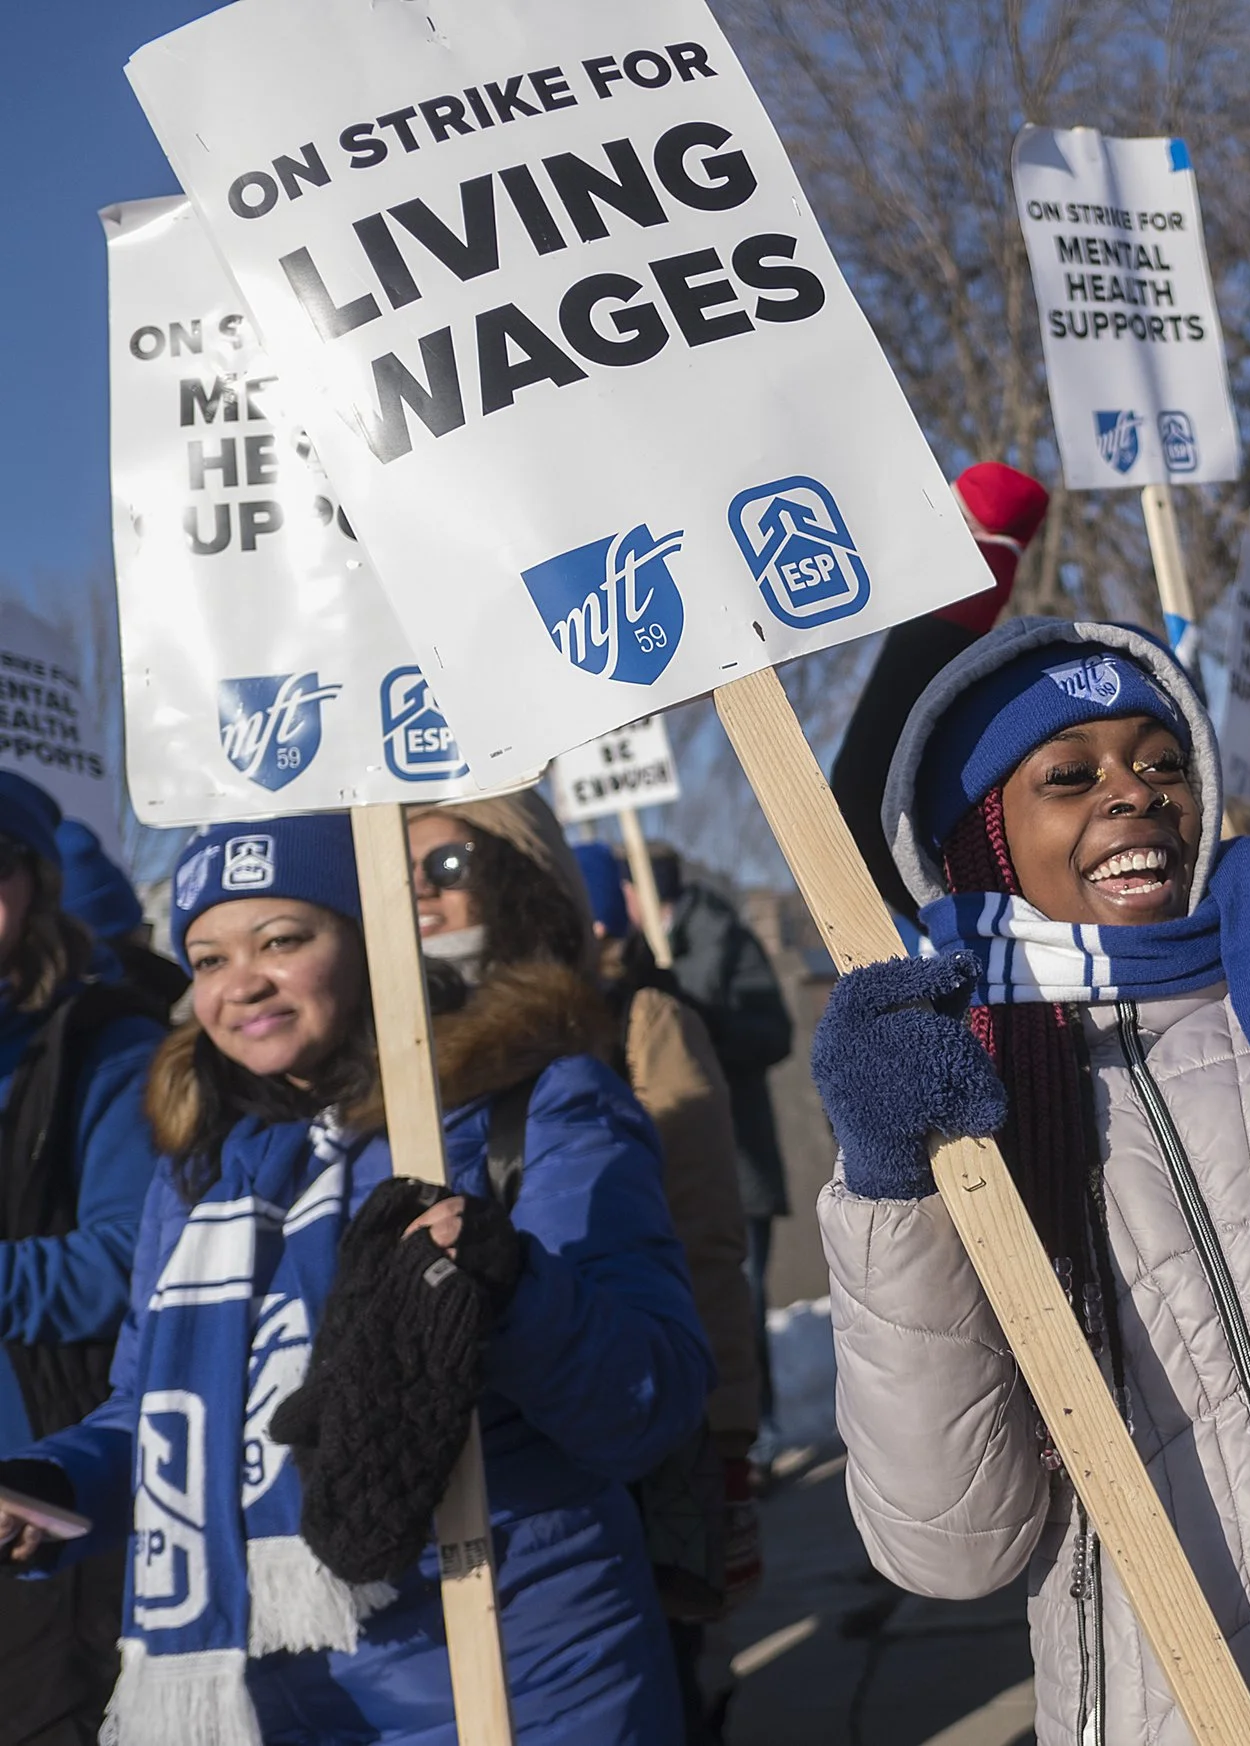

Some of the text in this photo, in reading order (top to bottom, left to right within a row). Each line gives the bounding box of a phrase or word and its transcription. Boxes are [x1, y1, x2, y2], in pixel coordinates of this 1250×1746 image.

[228, 41, 718, 220] ON STRIKE FOR
[279, 121, 758, 340] LIVING
[1027, 200, 1186, 231] ON STRIKE FOR
[1056, 235, 1171, 271] MENTAL
[1067, 272, 1174, 306] HEALTH
[129, 318, 203, 361] ON
[1050, 310, 1205, 342] SUPPORTS
[336, 233, 826, 465] WAGES
[781, 553, 836, 593] ESP
[634, 623, 668, 653] 59
[407, 728, 453, 753] ESP
[277, 747, 300, 770] 59
